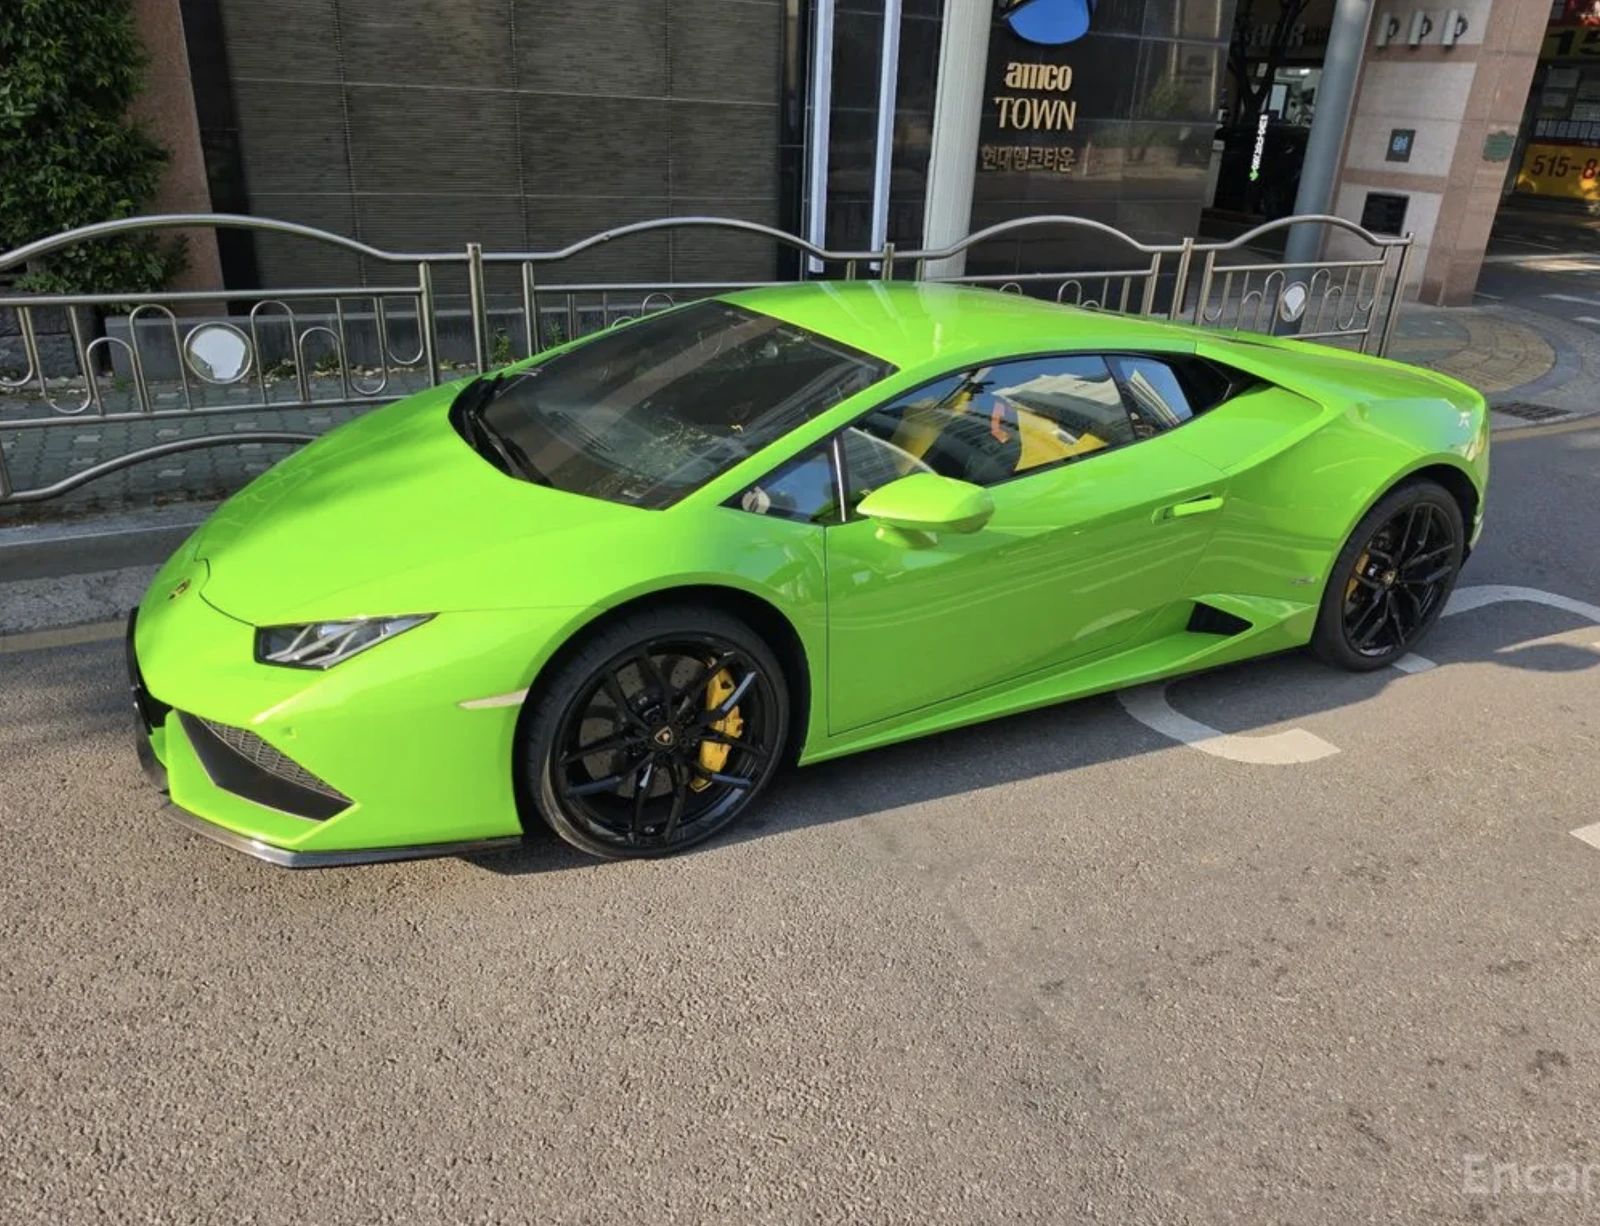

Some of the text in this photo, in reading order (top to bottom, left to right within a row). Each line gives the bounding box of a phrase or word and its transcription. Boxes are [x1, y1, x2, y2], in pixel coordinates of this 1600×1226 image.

[1004, 62, 1073, 92] amco
[994, 96, 1077, 132] TOWN
[981, 144, 1076, 173] 현대엠코타운
[1531, 154, 1600, 179] 515-8
